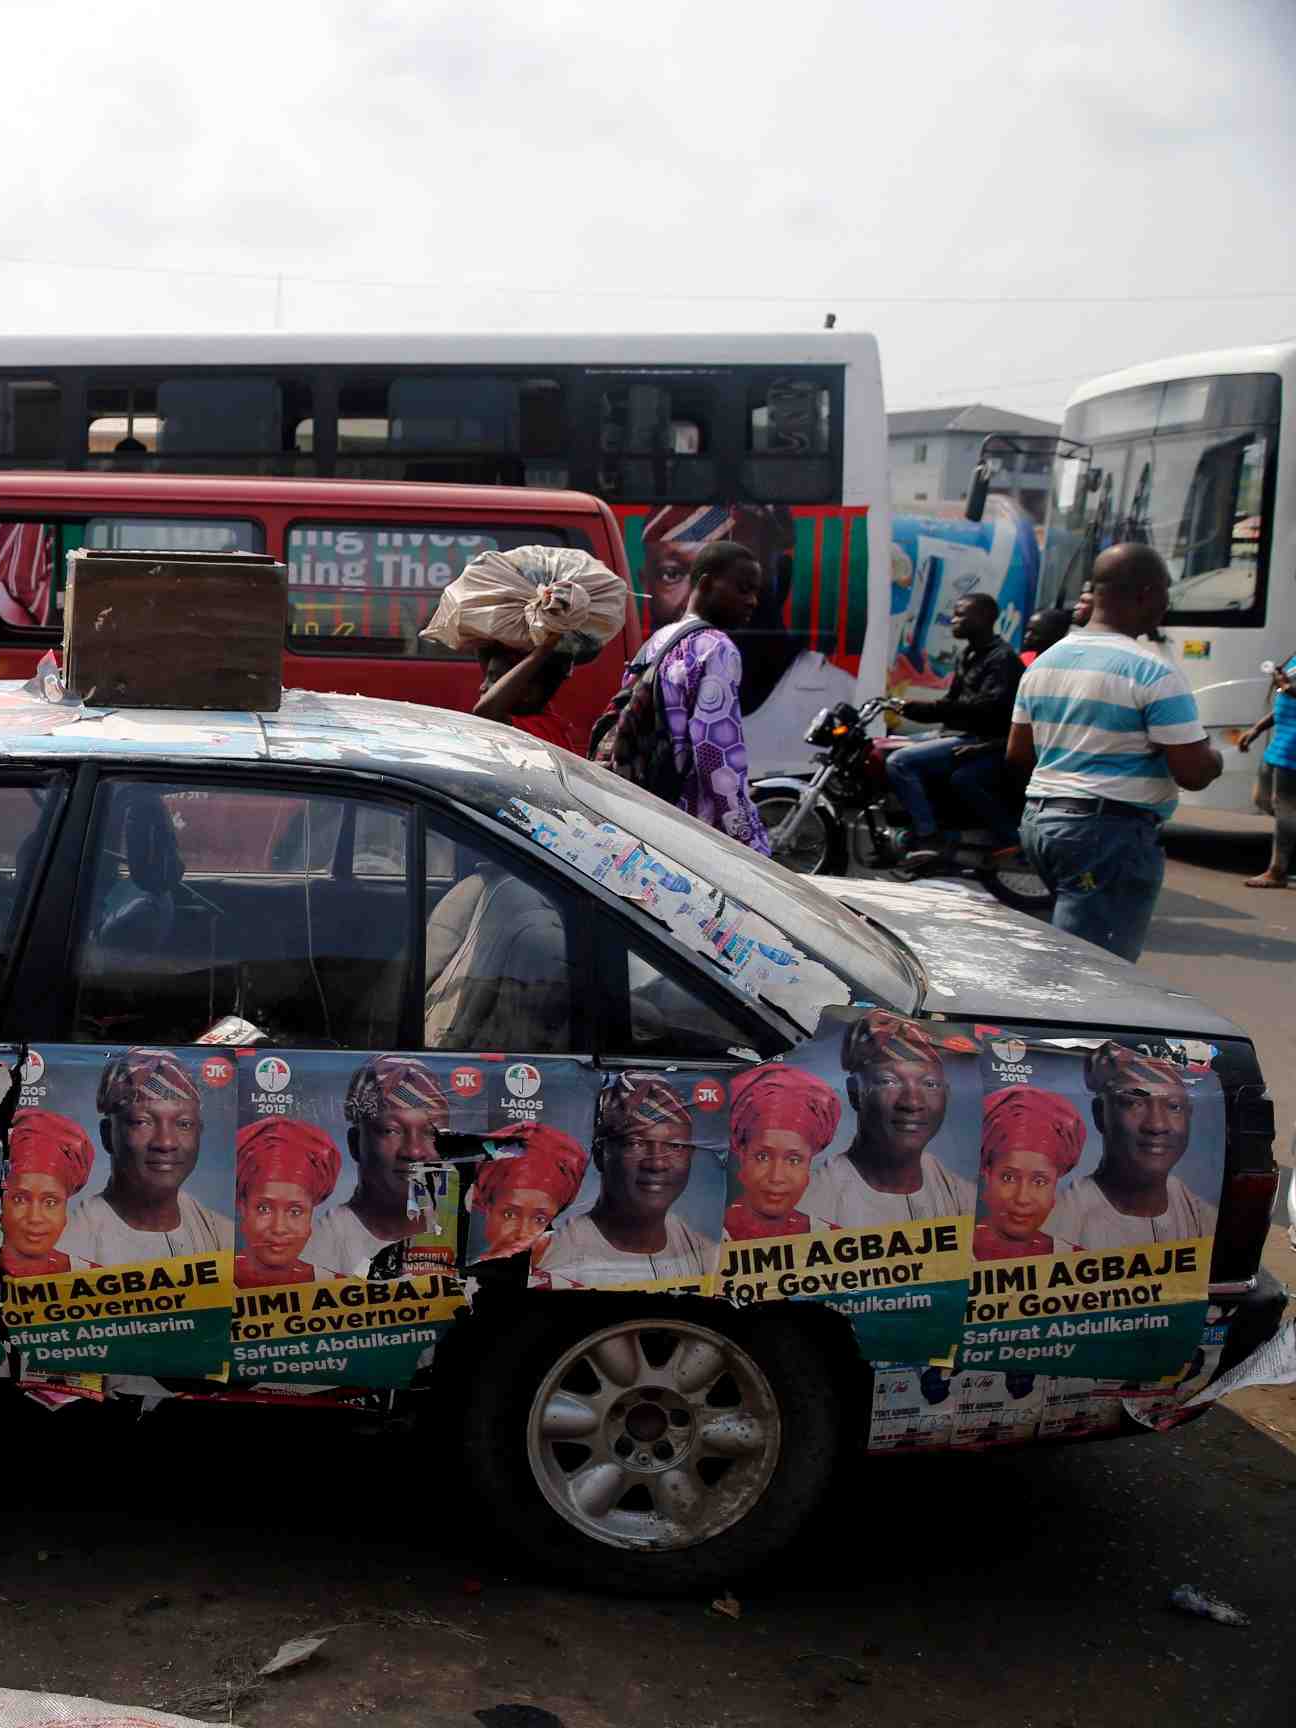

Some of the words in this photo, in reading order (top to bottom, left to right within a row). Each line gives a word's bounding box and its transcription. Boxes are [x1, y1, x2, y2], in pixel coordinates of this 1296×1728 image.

[377, 554, 452, 588] The
[991, 1063, 1033, 1075] LAGOS
[1000, 1073, 1028, 1084] 2015
[251, 1093, 294, 1105] LAGOS
[258, 1103, 287, 1115] 2015
[501, 1098, 544, 1110] LAGOS
[508, 1109, 536, 1120] 2015
[721, 1244, 795, 1278] JIMI
[805, 1225, 958, 1268] AGBAJE
[70, 1260, 220, 1299] AGBAJE
[722, 1279, 768, 1301] for
[777, 1261, 924, 1297] Governor
[967, 1264, 1037, 1298] JIMI
[1048, 1247, 1197, 1289] AGBAJE
[5, 1309, 35, 1326] or
[44, 1293, 187, 1322] Governor
[232, 1291, 301, 1320] JIMI
[311, 1275, 464, 1311] AGBAJE
[824, 1292, 932, 1316] bdulkarim
[964, 1299, 1009, 1323] for
[1018, 1282, 1163, 1317] Governor
[8, 1327, 70, 1346] afurat
[76, 1317, 195, 1340] Abdulkarim
[230, 1321, 274, 1342] for
[284, 1304, 431, 1335] Governor
[962, 1321, 1042, 1345] Safurat
[1045, 1314, 1169, 1339] Abdulkarim
[36, 1344, 108, 1361] Deputy
[234, 1342, 309, 1361] Safurat
[316, 1328, 437, 1353] Abdulkarim
[962, 1348, 993, 1364] for
[999, 1341, 1076, 1361] Deputy
[237, 1362, 267, 1377] for
[273, 1357, 348, 1375] Deputy
